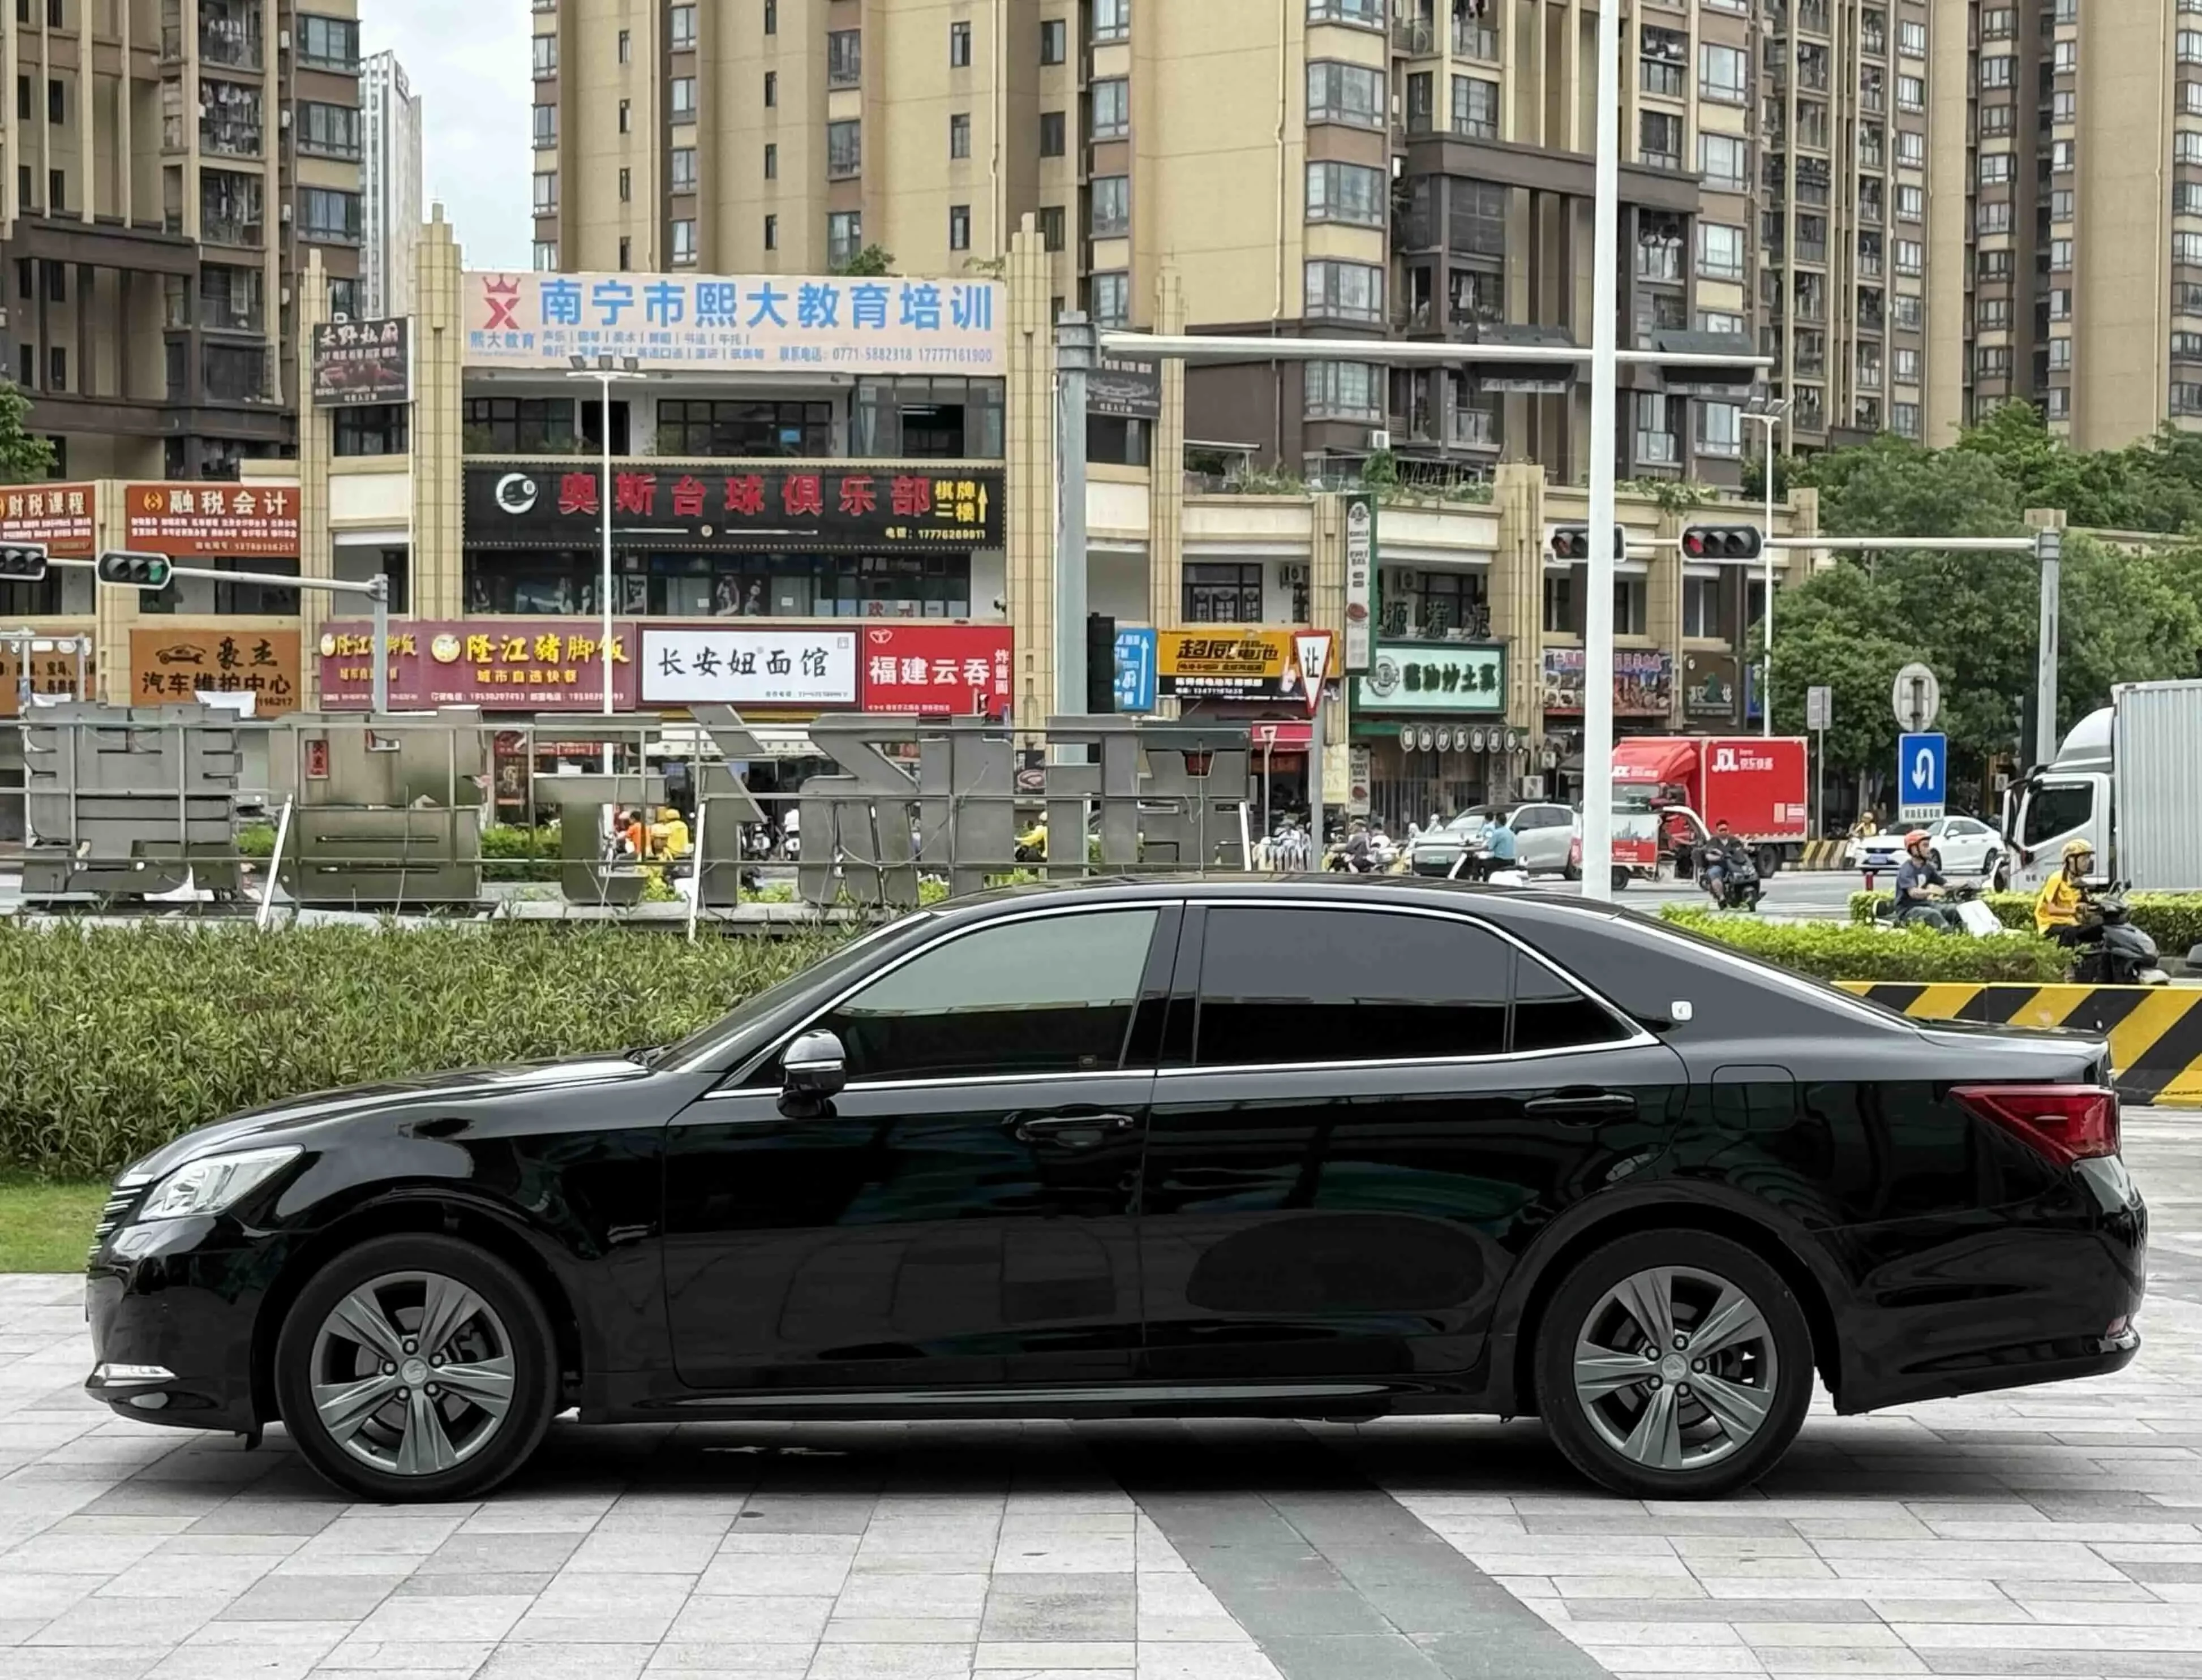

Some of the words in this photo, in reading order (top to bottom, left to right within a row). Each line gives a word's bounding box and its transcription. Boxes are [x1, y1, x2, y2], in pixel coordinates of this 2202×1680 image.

[540, 278, 992, 331] 南宁市熙大教育培训
[170, 489, 287, 516] 融税会计
[559, 472, 931, 516] 奥斯台球俱乐部
[217, 636, 277, 671] 豪杰
[466, 633, 630, 664] 隆江猪脚饭
[658, 646, 829, 677] 长安妞面馆
[1304, 647, 1319, 678] 让
[142, 671, 291, 694] 汽车维护中心
[869, 656, 990, 686] 福建云吞
[1711, 748, 1739, 772] JDL
